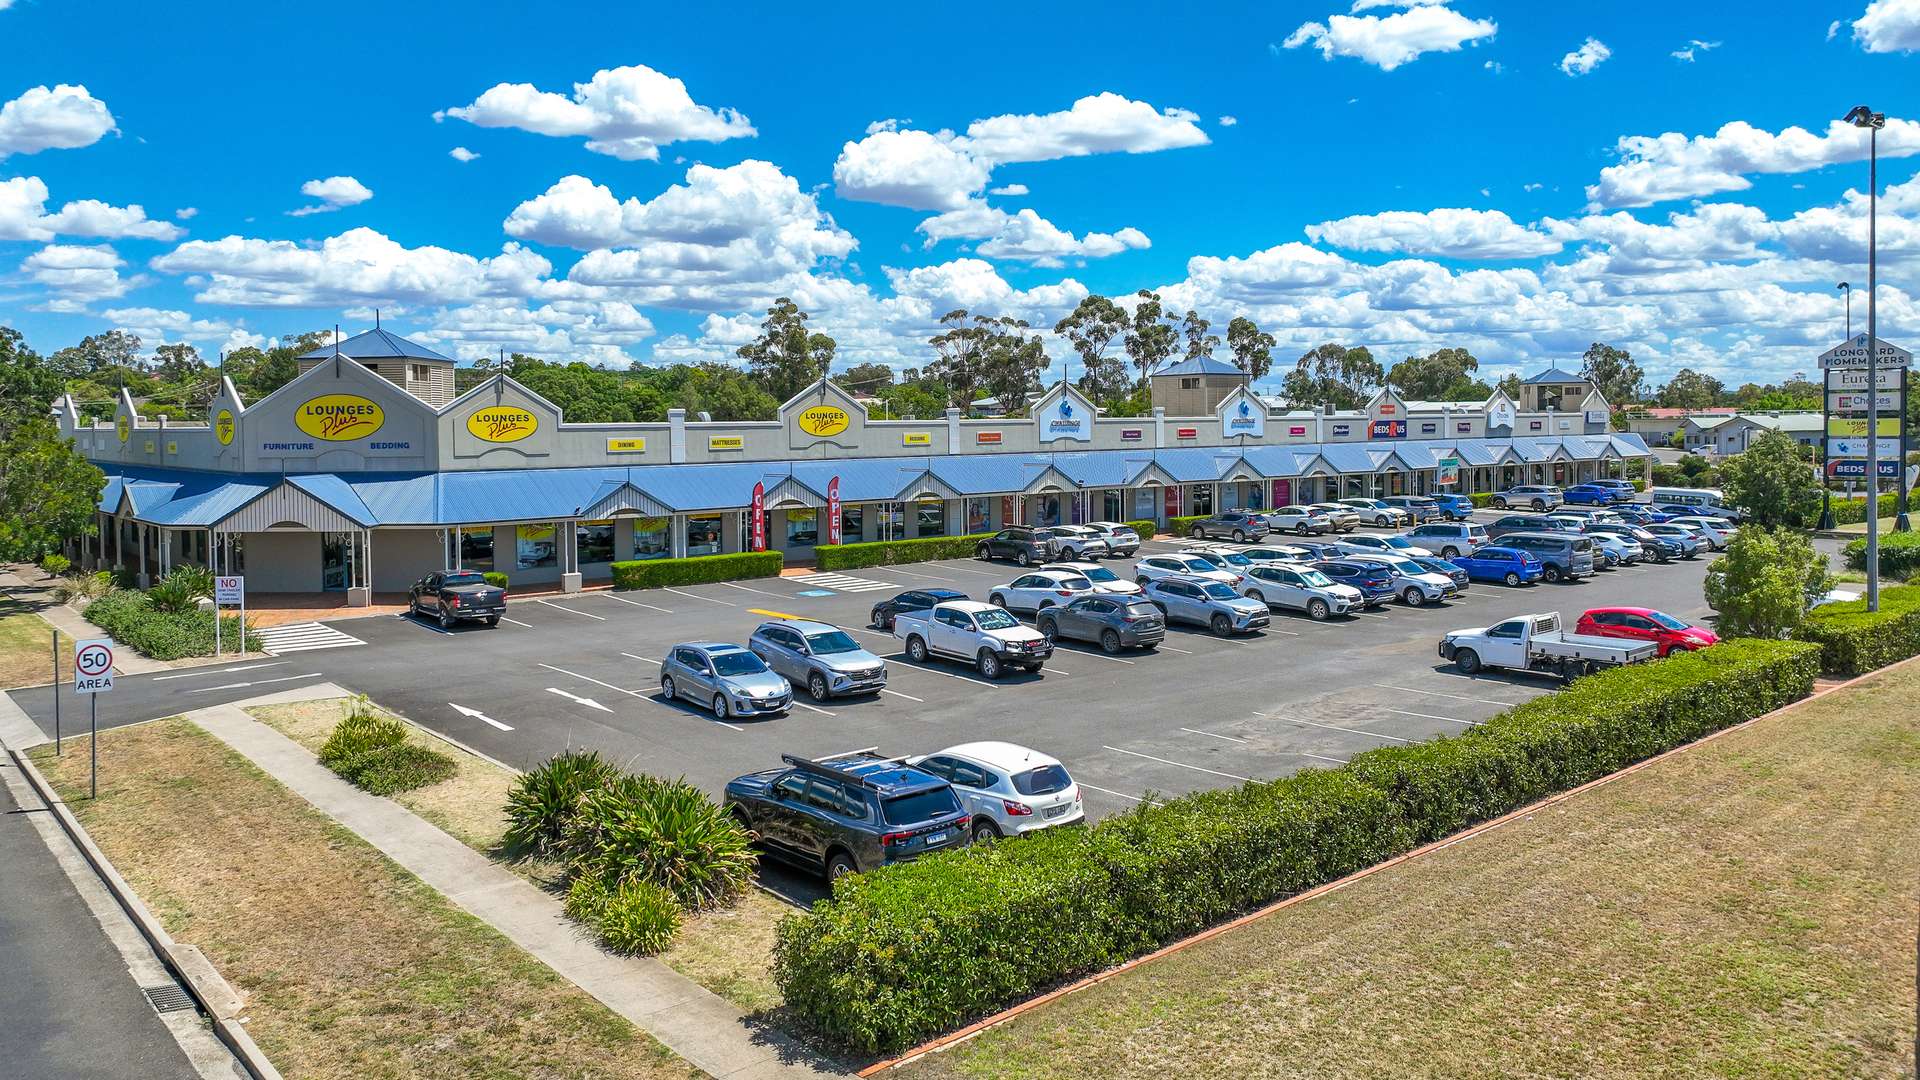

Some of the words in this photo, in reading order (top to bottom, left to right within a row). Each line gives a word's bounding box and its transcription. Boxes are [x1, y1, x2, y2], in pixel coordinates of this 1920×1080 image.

[1834, 347, 1895, 357] LONGYRD
[1825, 356, 1905, 366] HOMEMKERS
[306, 405, 375, 415] LOUNGES
[476, 414, 530, 422] LOUNGES
[805, 412, 844, 420] LOUNGES
[320, 412, 362, 438] Plus
[487, 420, 519, 439] Plus
[1373, 425, 1389, 434] BEDS
[1397, 425, 1405, 433] US
[1836, 465, 1865, 473] BEDS
[1879, 466, 1894, 474] US
[830, 488, 841, 540] OPEN
[221, 578, 237, 588] NO
[82, 652, 107, 669] 50
[77, 678, 112, 690] AREA
